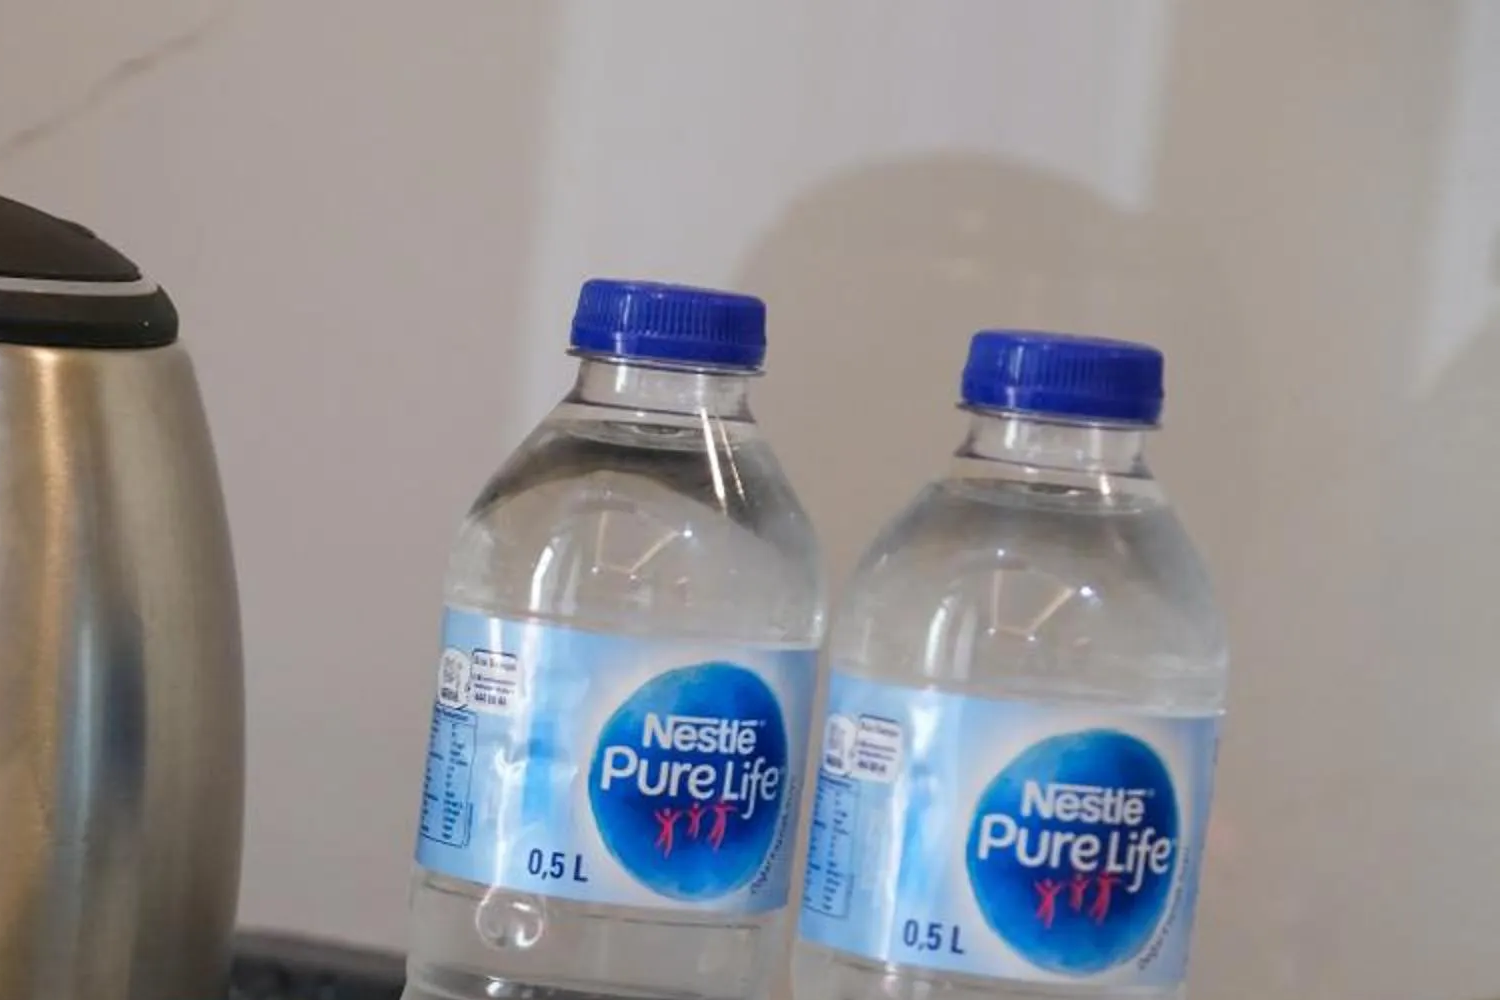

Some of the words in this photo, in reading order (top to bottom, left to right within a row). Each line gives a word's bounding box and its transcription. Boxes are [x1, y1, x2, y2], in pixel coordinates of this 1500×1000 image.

[601, 745, 717, 800] Pure
[721, 757, 779, 820] Life
[527, 848, 565, 879] 0,5
[573, 854, 589, 882] L
[977, 813, 1100, 871] Pure
[1105, 827, 1171, 894] Life
[902, 918, 942, 952] 0,5
[949, 924, 965, 955] L
